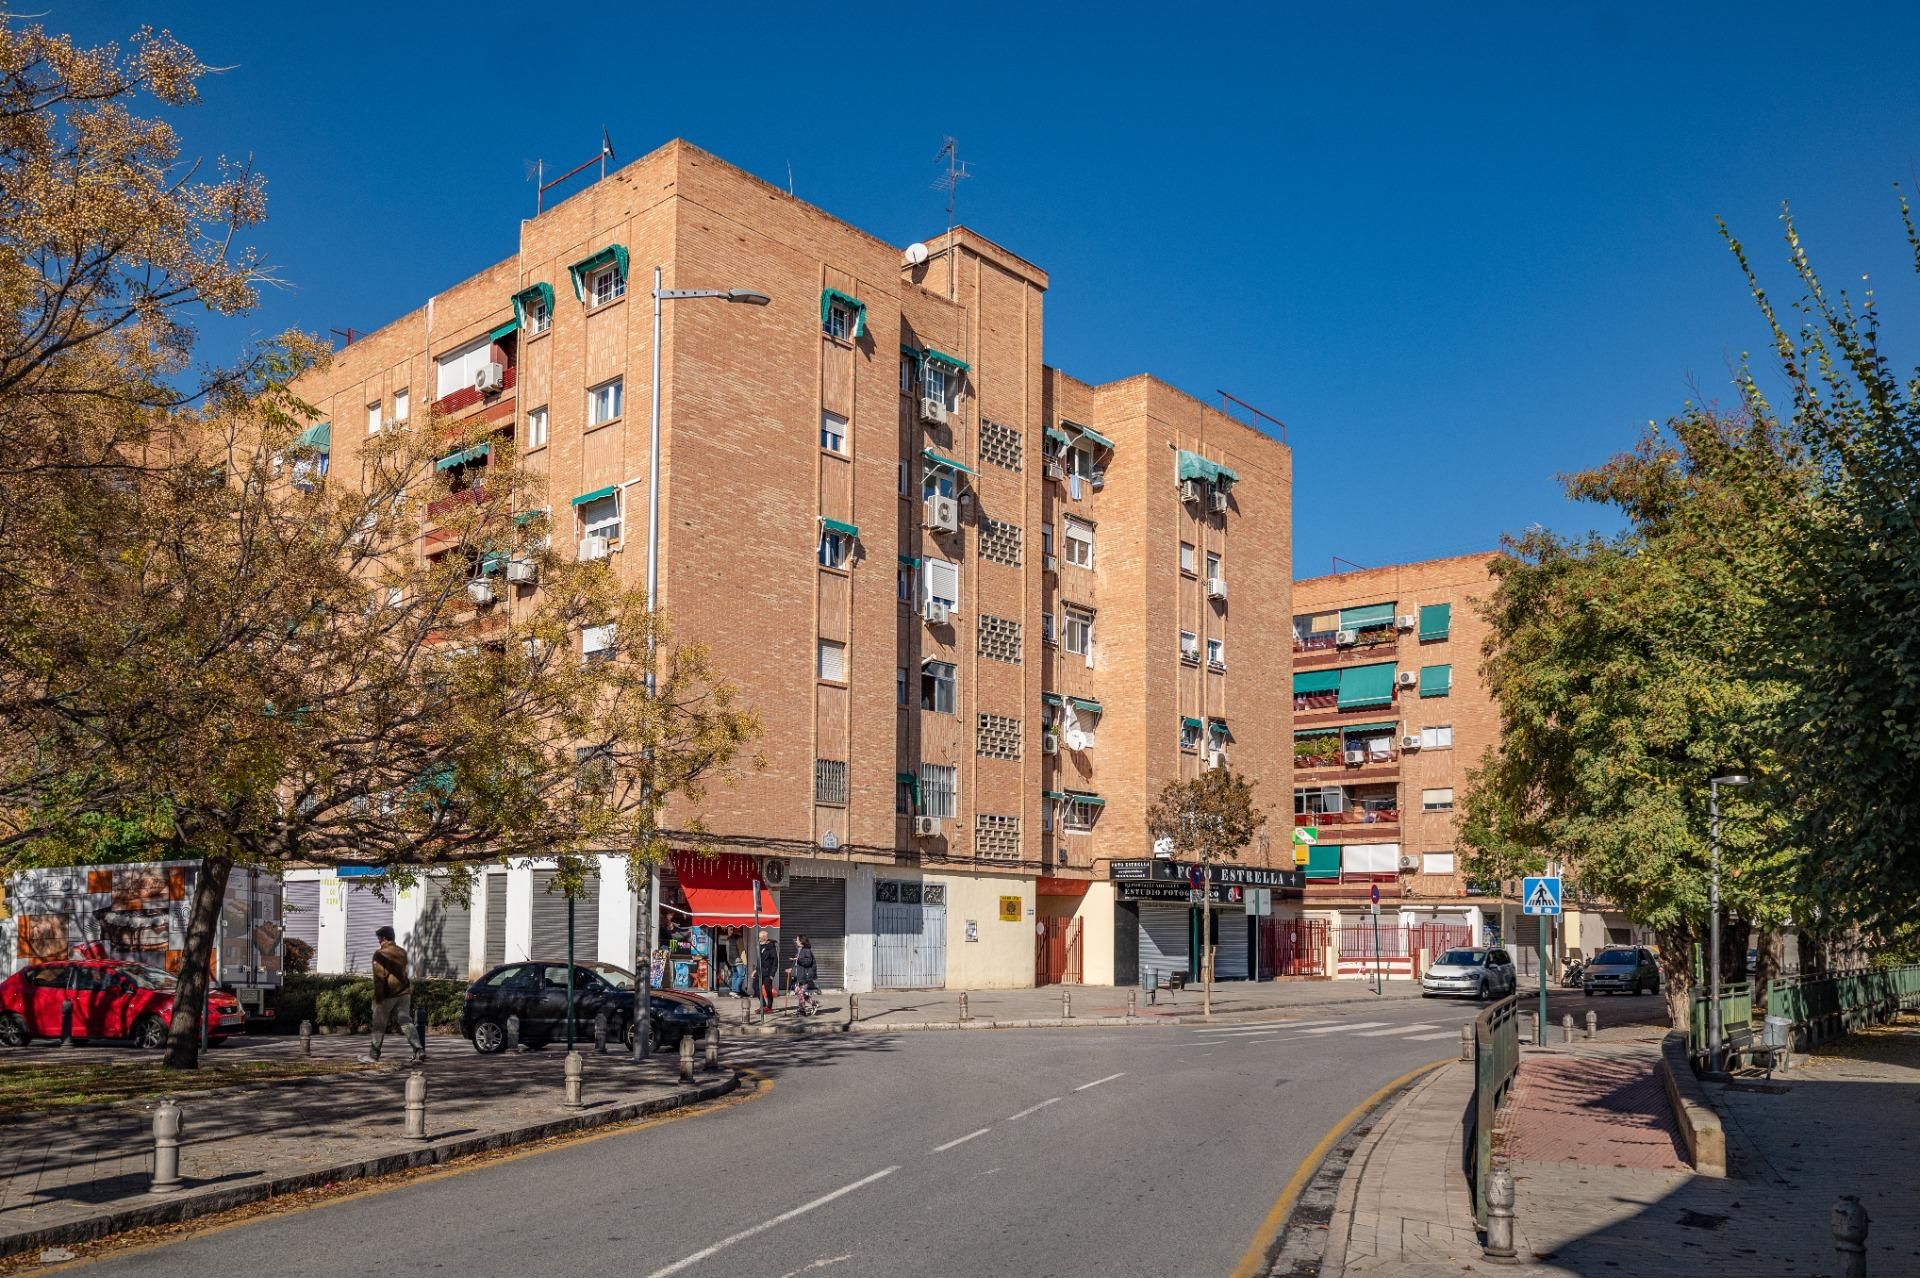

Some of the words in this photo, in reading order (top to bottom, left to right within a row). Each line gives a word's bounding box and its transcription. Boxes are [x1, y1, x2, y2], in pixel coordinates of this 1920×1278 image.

[1176, 865, 1212, 880] FOO
[1221, 868, 1285, 885] ESTRELLA
[1124, 888, 1161, 896] ESTUDIO
